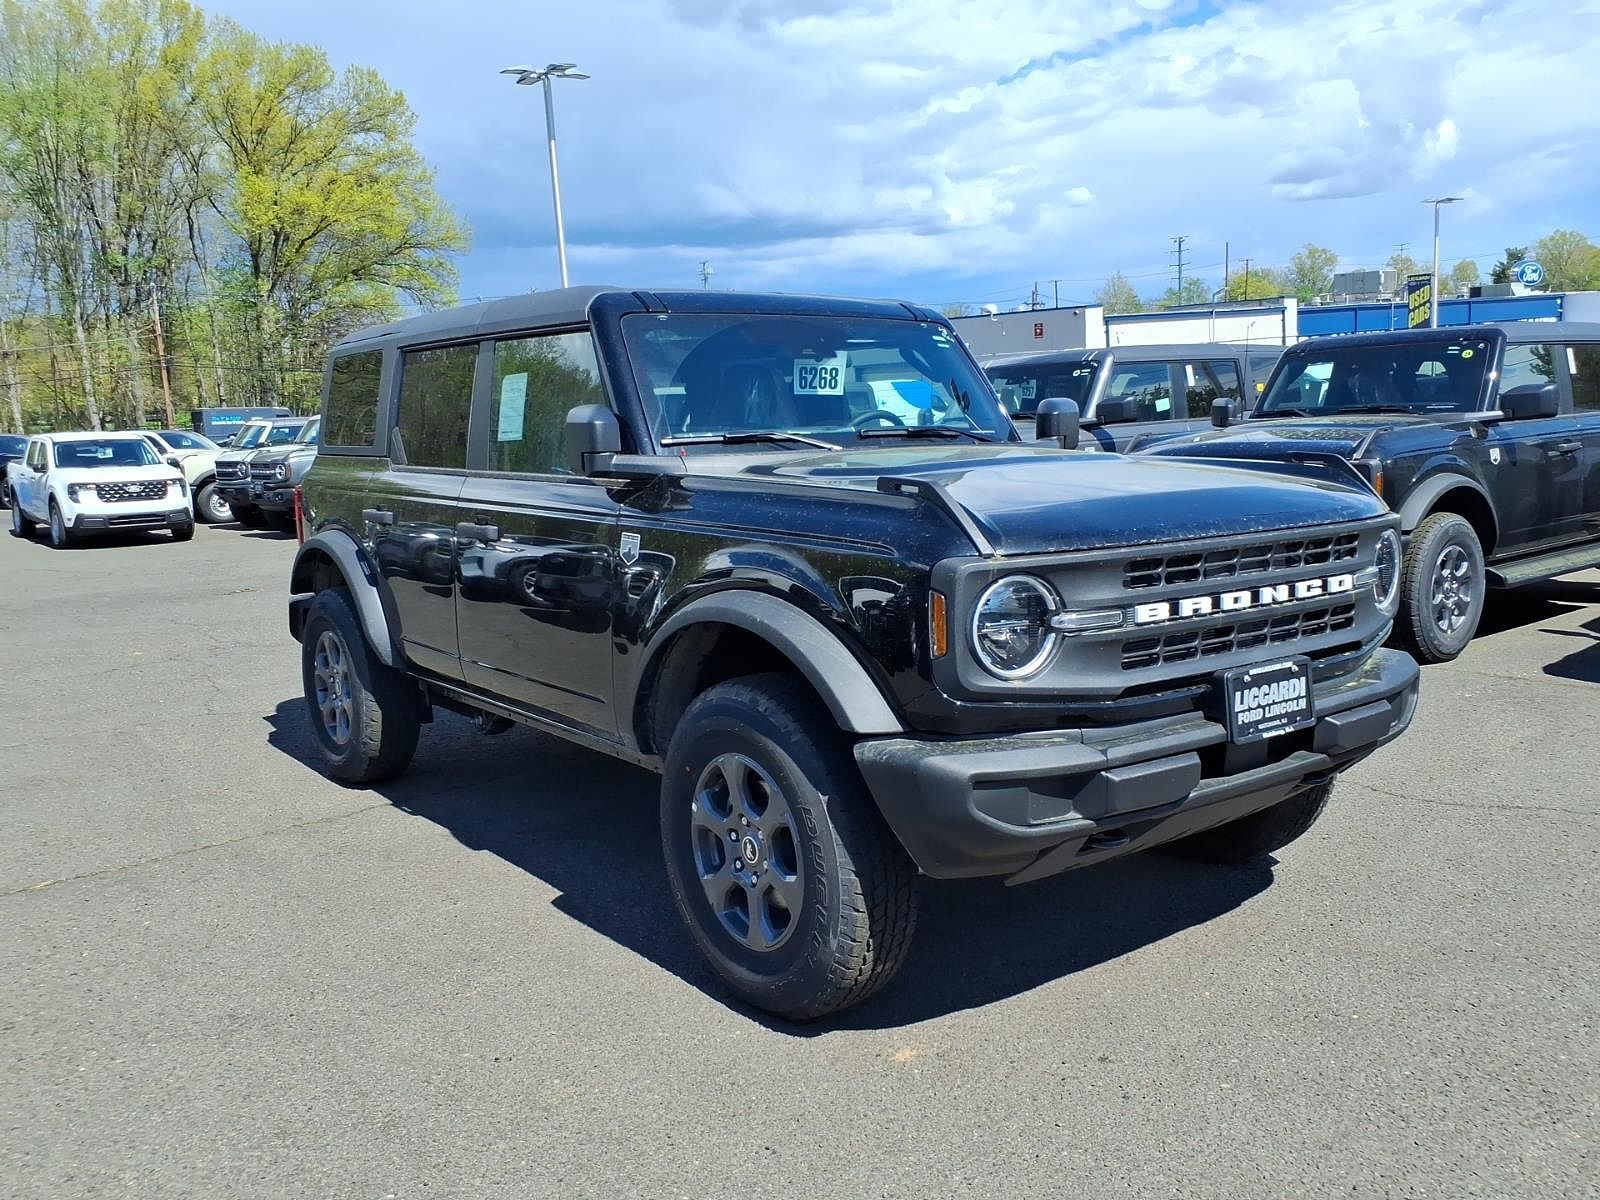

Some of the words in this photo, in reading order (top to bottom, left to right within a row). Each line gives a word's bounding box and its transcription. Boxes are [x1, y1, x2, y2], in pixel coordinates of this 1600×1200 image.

[1523, 265, 1540, 281] Ford
[1408, 285, 1431, 309] USED
[1408, 302, 1431, 328] CARS
[799, 366, 839, 390] 6268
[1134, 574, 1353, 624] BRONCO
[1235, 677, 1306, 712] LICCARDI
[1238, 708, 1263, 725] FORD
[1265, 698, 1306, 717] LINCOLN
[800, 806, 828, 969] DUEL
